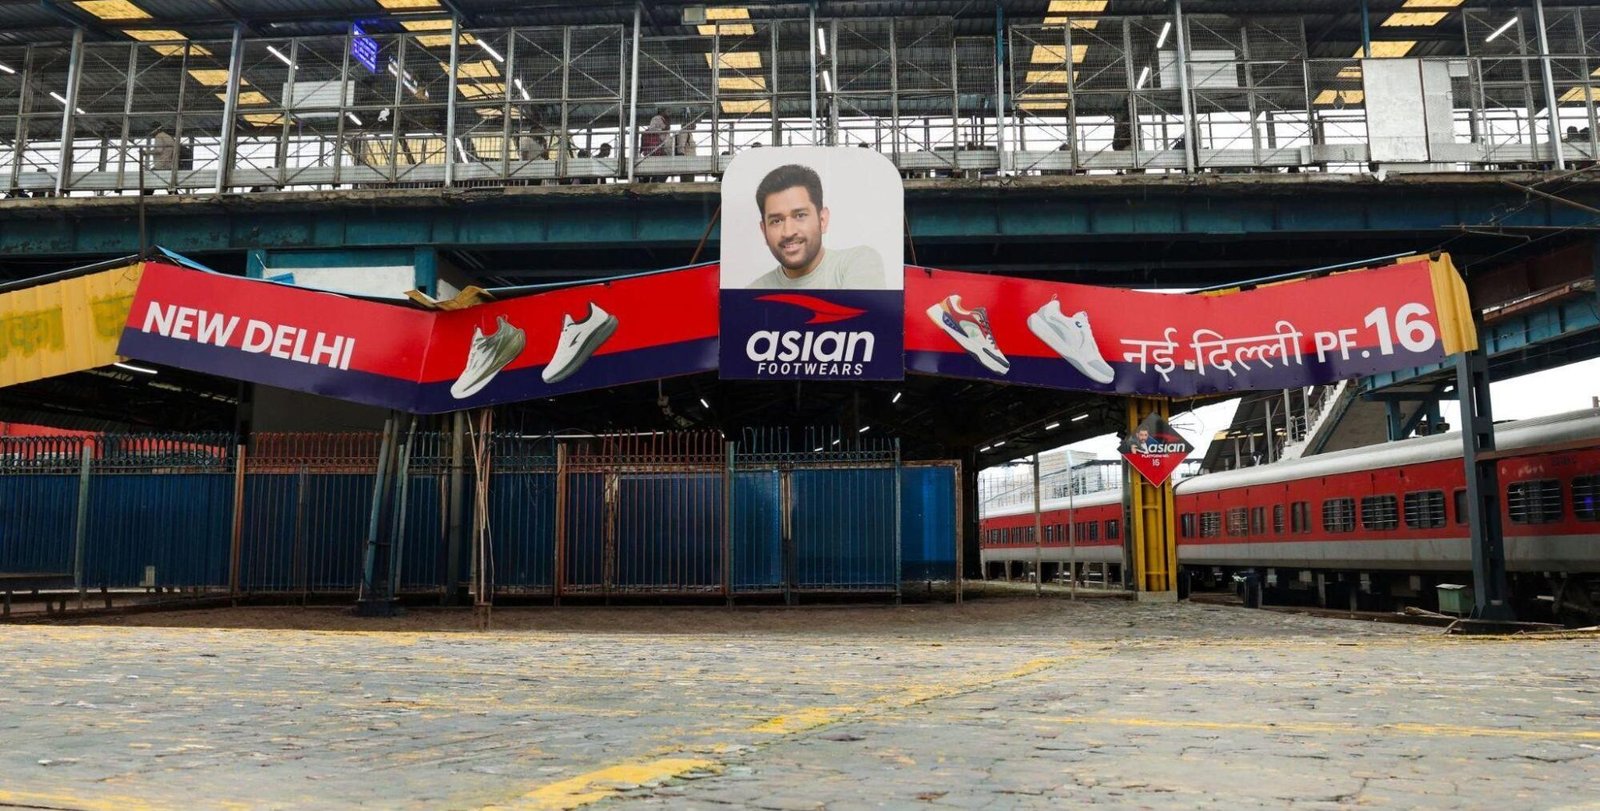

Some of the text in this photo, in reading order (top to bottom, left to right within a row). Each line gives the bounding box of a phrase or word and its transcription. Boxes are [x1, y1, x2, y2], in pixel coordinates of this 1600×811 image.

[142, 301, 240, 347] NEW
[241, 319, 355, 371] DELHI
[746, 330, 875, 362] asian
[1120, 327, 1178, 382] नई
[1190, 320, 1303, 376] दिल्ली
[757, 363, 863, 375] FOOTWEARS
[1148, 443, 1185, 453] asian
